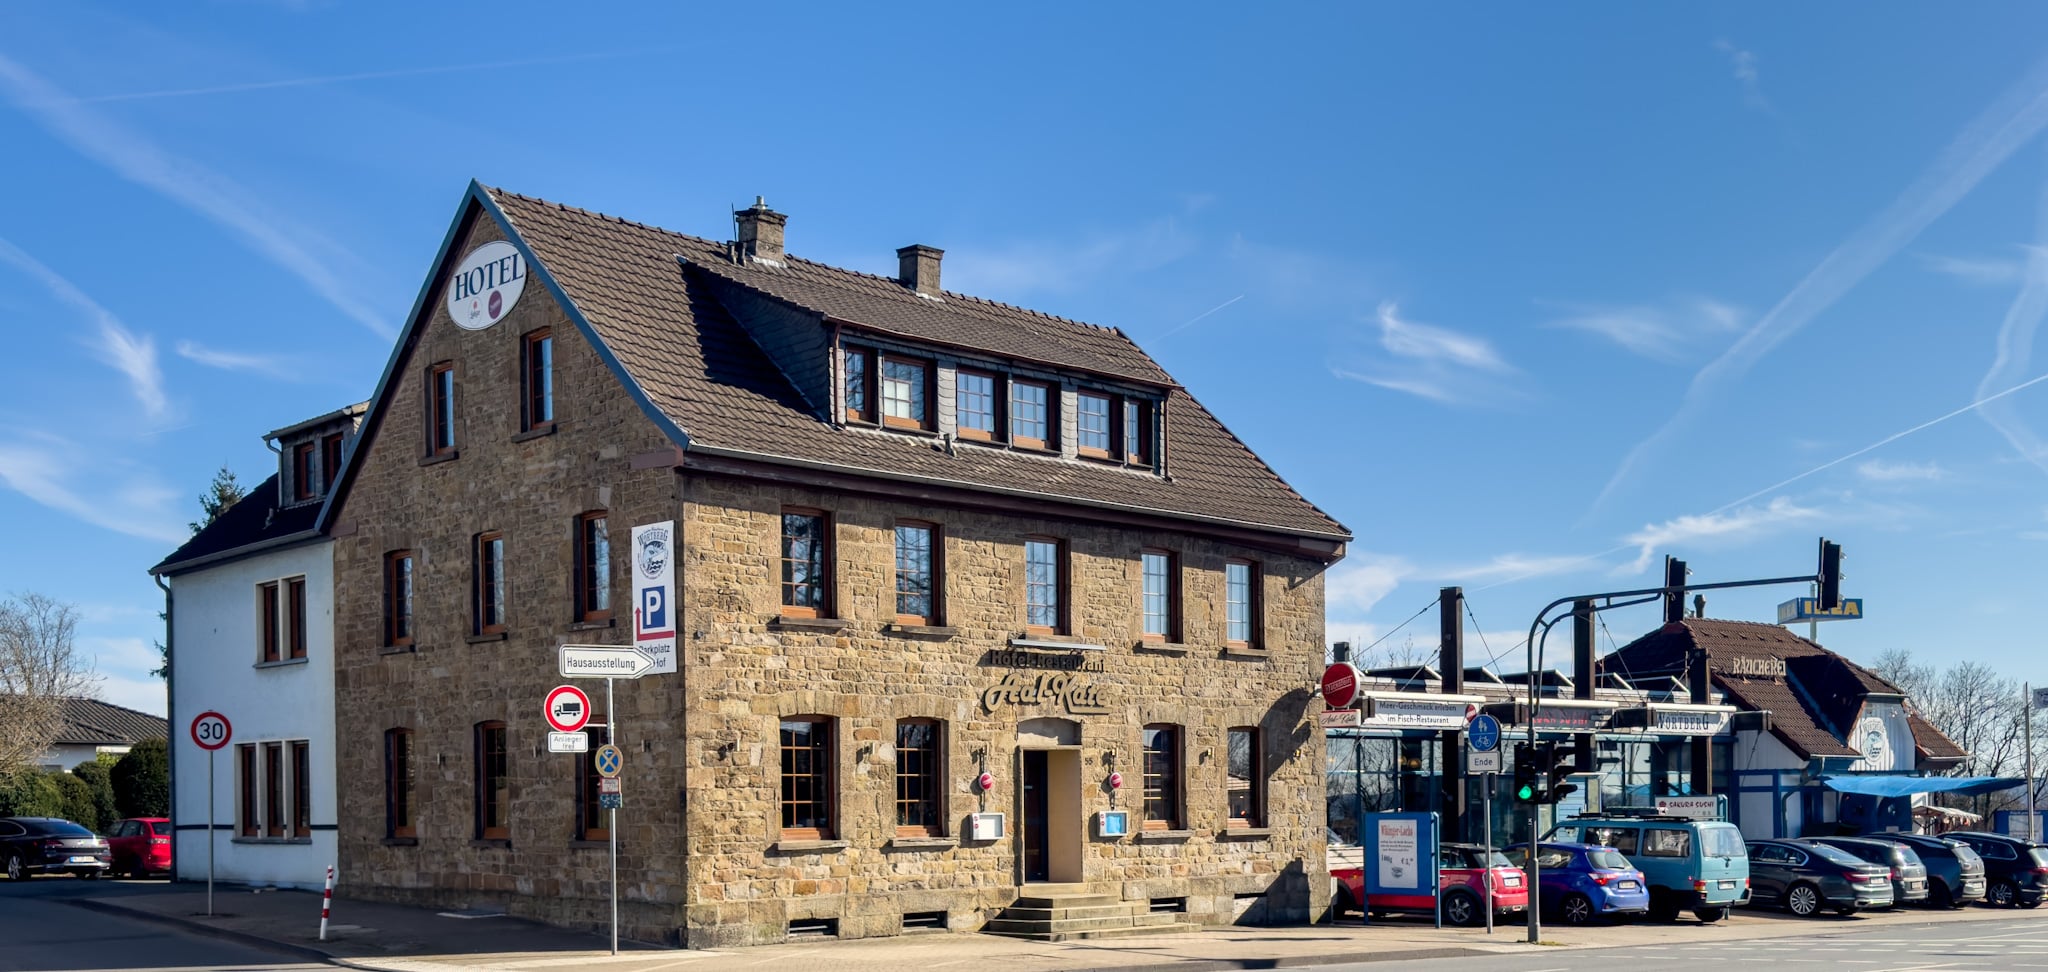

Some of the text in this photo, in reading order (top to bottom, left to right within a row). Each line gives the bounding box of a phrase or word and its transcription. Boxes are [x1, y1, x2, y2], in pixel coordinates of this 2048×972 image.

[454, 253, 524, 302] HOTEL
[645, 590, 662, 626] P
[567, 657, 636, 671] Hausausstellung
[984, 672, 1112, 714] Aal-Kate
[1379, 702, 1434, 711] Meer-Geschmack
[1387, 715, 1449, 724] im Fisch-Restaurant
[1656, 712, 1710, 730] WORTBERG
[200, 722, 223, 740] 30
[553, 735, 583, 744] Anlieger
[1084, 757, 1093, 765] 55
[1474, 758, 1493, 766] Ende
